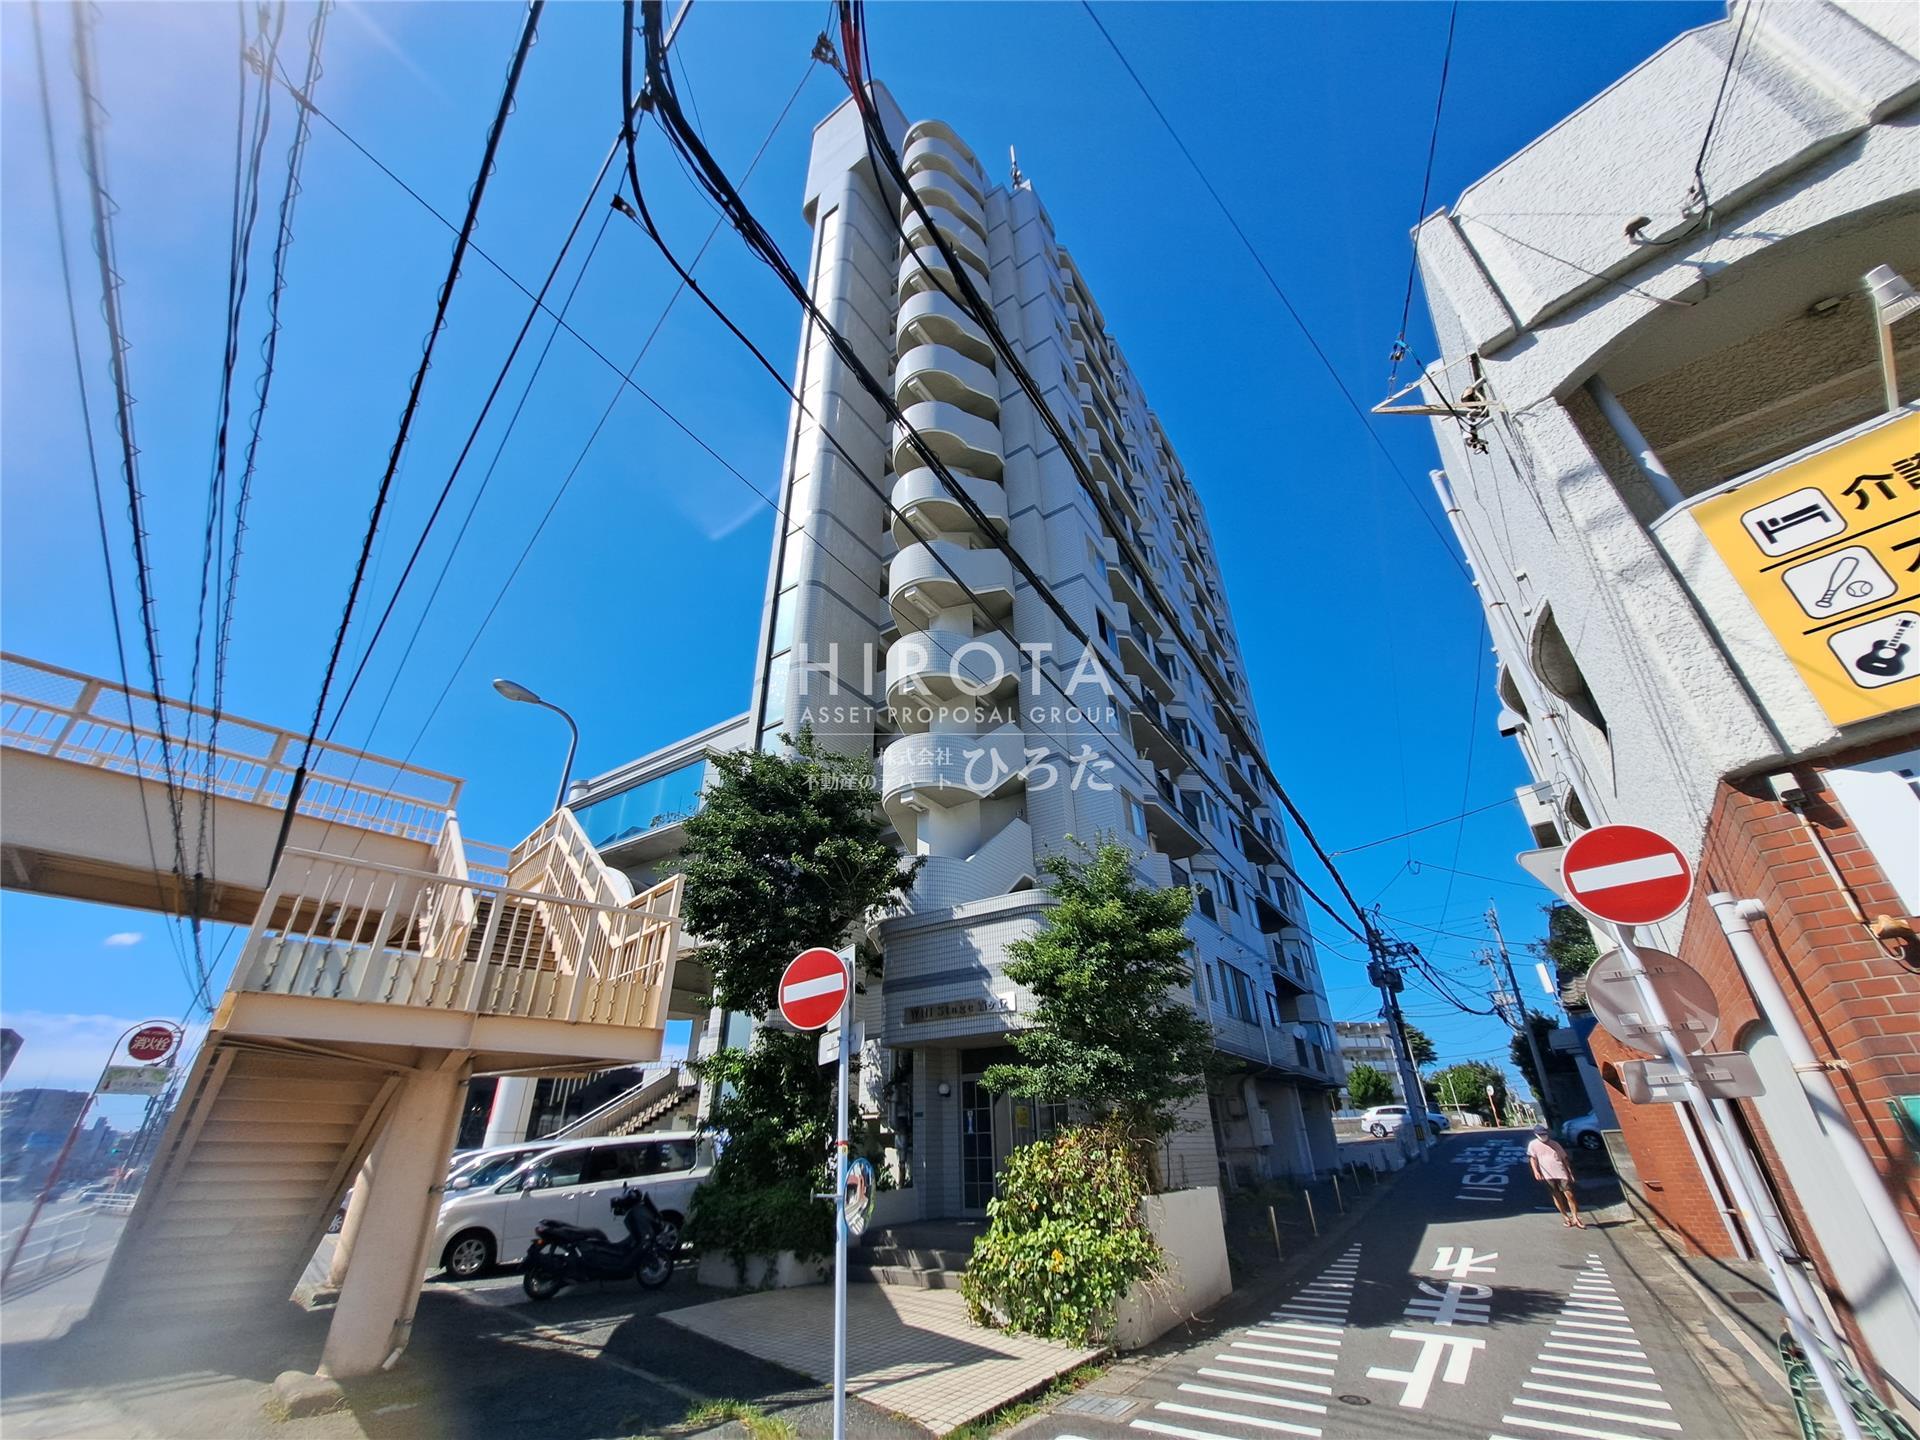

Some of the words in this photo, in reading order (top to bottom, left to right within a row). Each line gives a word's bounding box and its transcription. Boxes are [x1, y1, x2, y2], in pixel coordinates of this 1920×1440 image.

[131, 1036, 170, 1051] 消火栓
[1365, 1247, 1498, 1409] 止まれ
